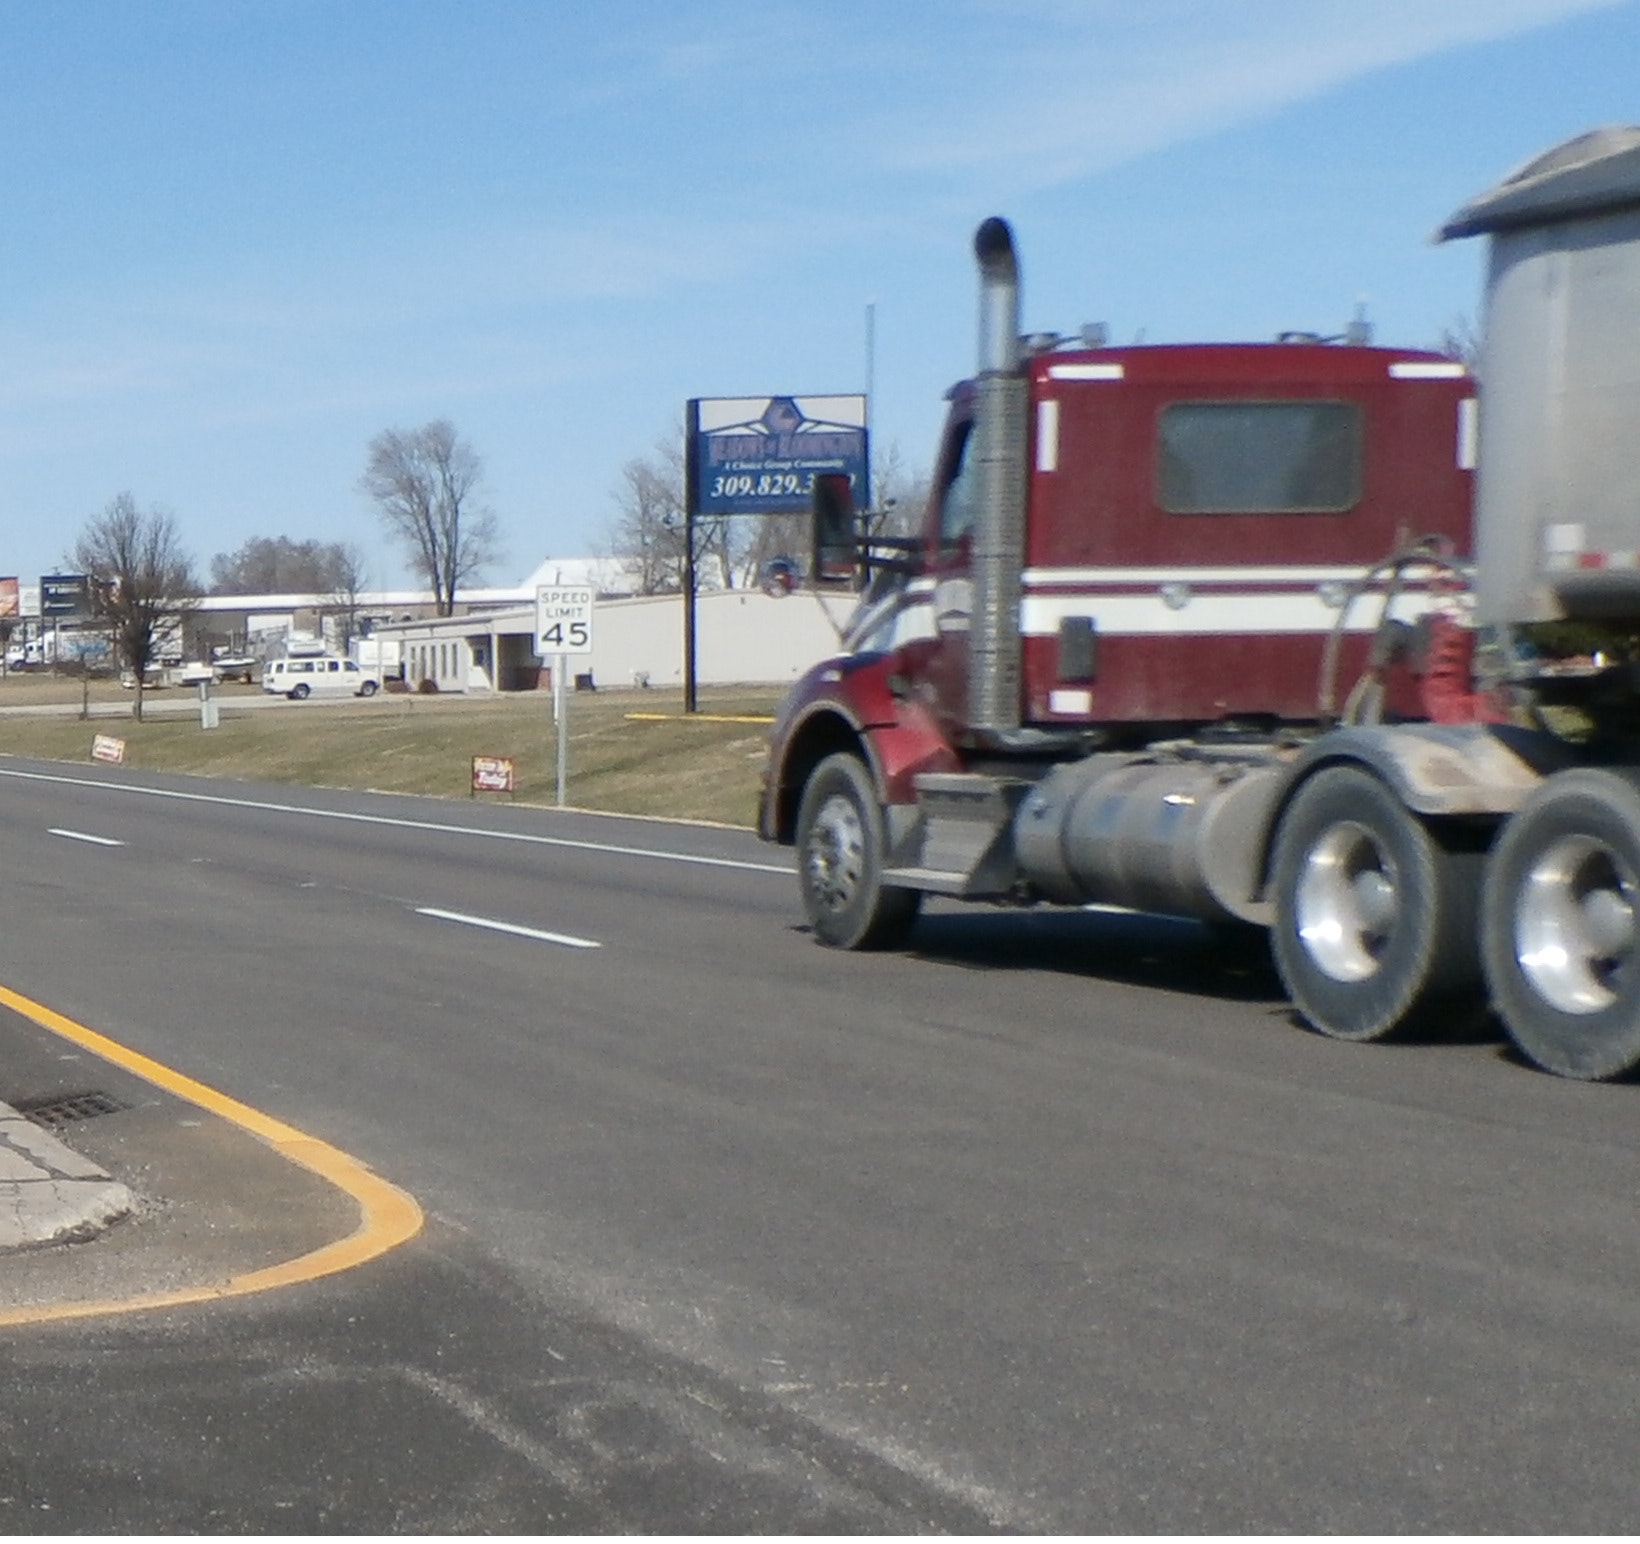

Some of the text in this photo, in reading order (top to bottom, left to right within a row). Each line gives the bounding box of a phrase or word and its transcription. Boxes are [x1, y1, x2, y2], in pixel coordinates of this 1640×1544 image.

[710, 473, 856, 498] 309.829.3
[541, 592, 590, 604] SPEED
[545, 607, 583, 618] LIMIT
[541, 622, 589, 647] 45
